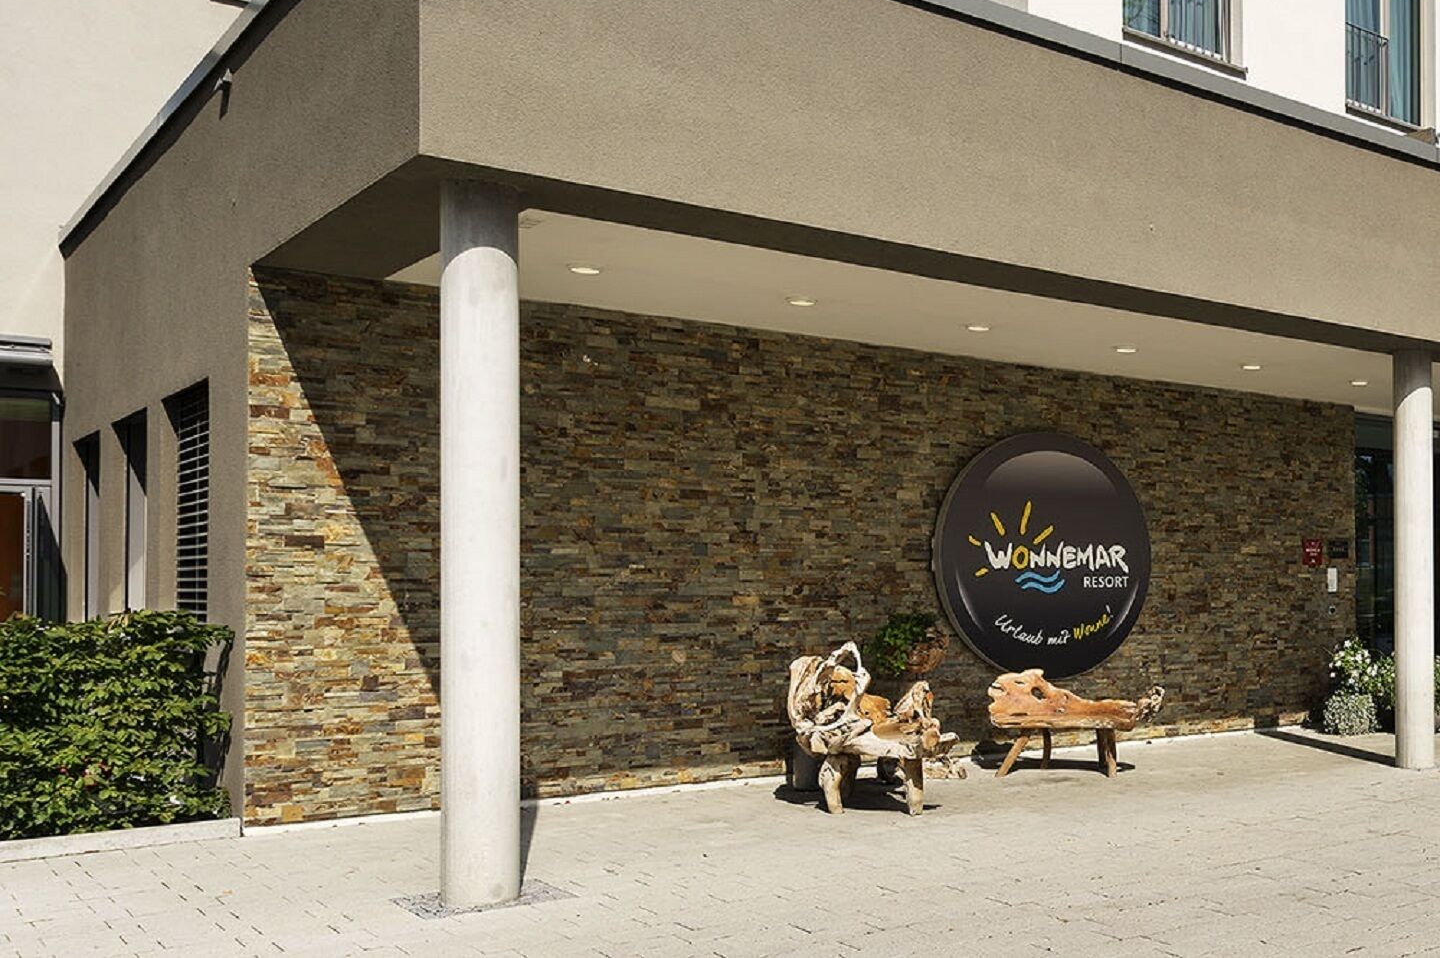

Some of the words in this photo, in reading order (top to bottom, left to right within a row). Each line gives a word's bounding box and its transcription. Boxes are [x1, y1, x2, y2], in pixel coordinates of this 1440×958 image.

[984, 541, 1129, 573] WONNEMAR
[1083, 576, 1129, 588] RESORT
[994, 614, 1043, 645] Urlaub
[1046, 629, 1071, 645] mit
